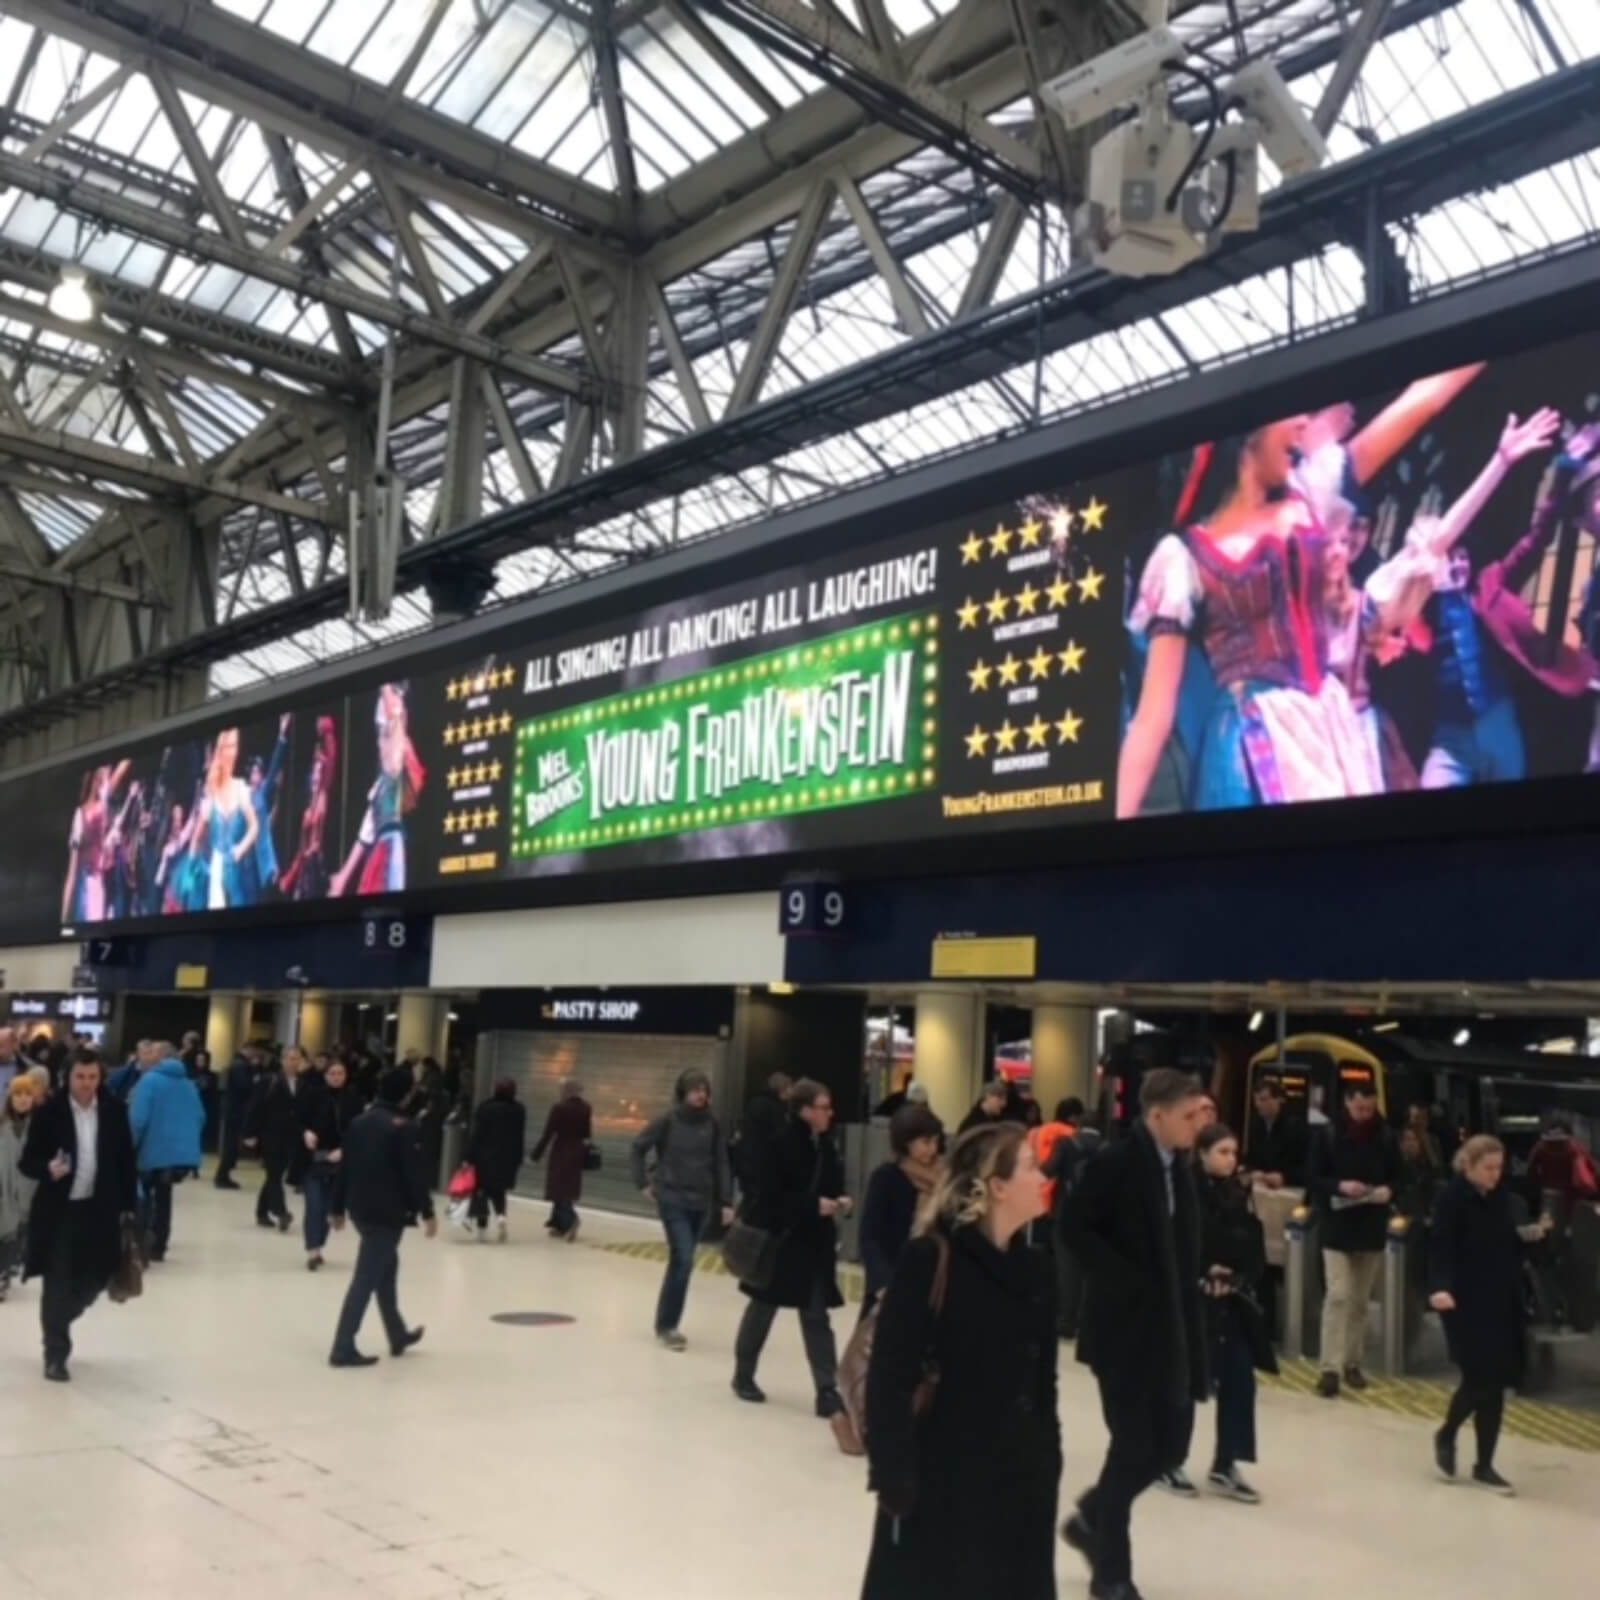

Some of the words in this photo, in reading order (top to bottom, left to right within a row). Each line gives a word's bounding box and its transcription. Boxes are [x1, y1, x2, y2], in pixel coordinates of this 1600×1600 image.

[523, 654, 553, 694] ALL
[555, 634, 628, 686] SINGING!
[629, 625, 663, 668] ALL
[666, 598, 759, 658] DANCING!
[762, 586, 802, 636] ALL
[807, 547, 938, 622] LAUGHING!
[585, 717, 681, 820] YOUNG
[686, 649, 914, 803] FRANKENSTEIN
[537, 747, 571, 789] MEL
[787, 889, 806, 926] 9
[823, 890, 844, 927] 9
[98, 941, 112, 962] 7
[388, 920, 406, 948] 8
[553, 1000, 597, 1020] PASTY
[598, 1000, 639, 1020] SHOP
